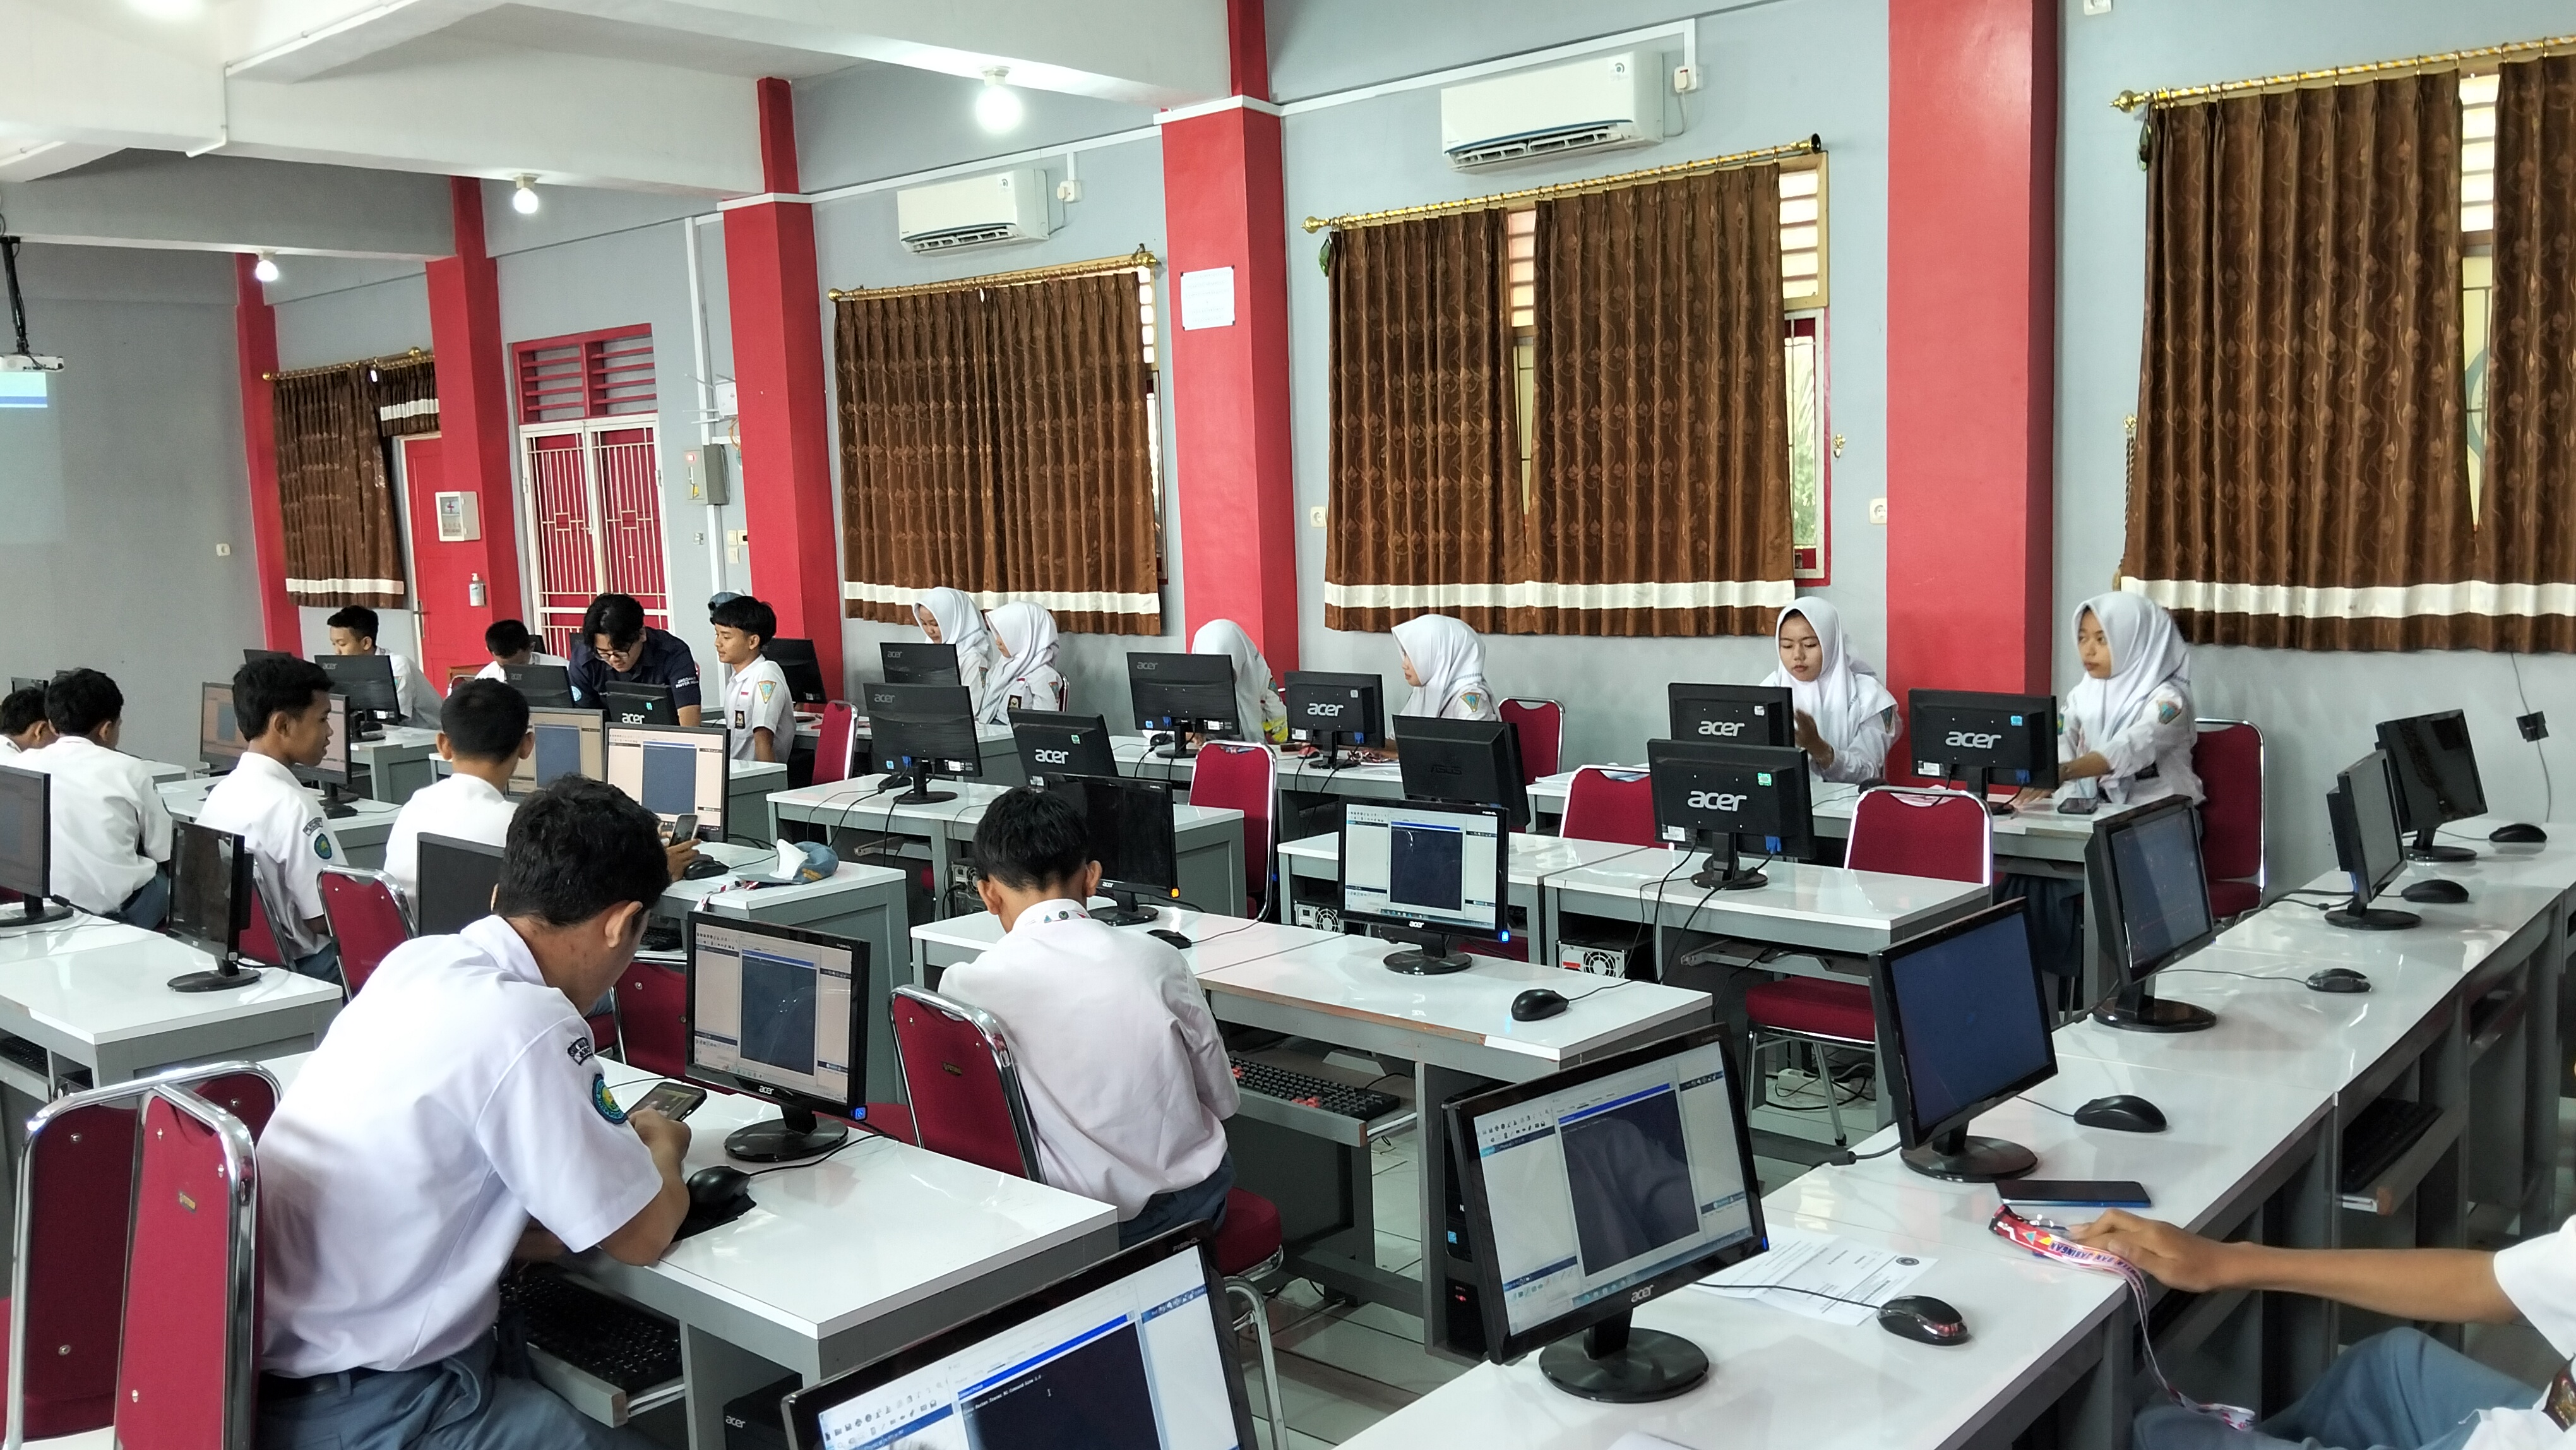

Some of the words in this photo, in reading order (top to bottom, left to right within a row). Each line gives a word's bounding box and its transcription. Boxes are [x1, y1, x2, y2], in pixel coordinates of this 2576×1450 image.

[1136, 661, 1159, 669] acer
[874, 694, 895, 703] acer
[1307, 703, 1344, 716] acer
[622, 713, 645, 724] acer
[1698, 721, 1745, 736] acer
[1945, 731, 2001, 749] acer
[1035, 749, 1069, 764] acer
[1431, 764, 1462, 775] ASUS
[1688, 791, 1747, 812] acer
[759, 1086, 774, 1094] acer
[1631, 1285, 1654, 1303] acer
[725, 1415, 746, 1428] acer
